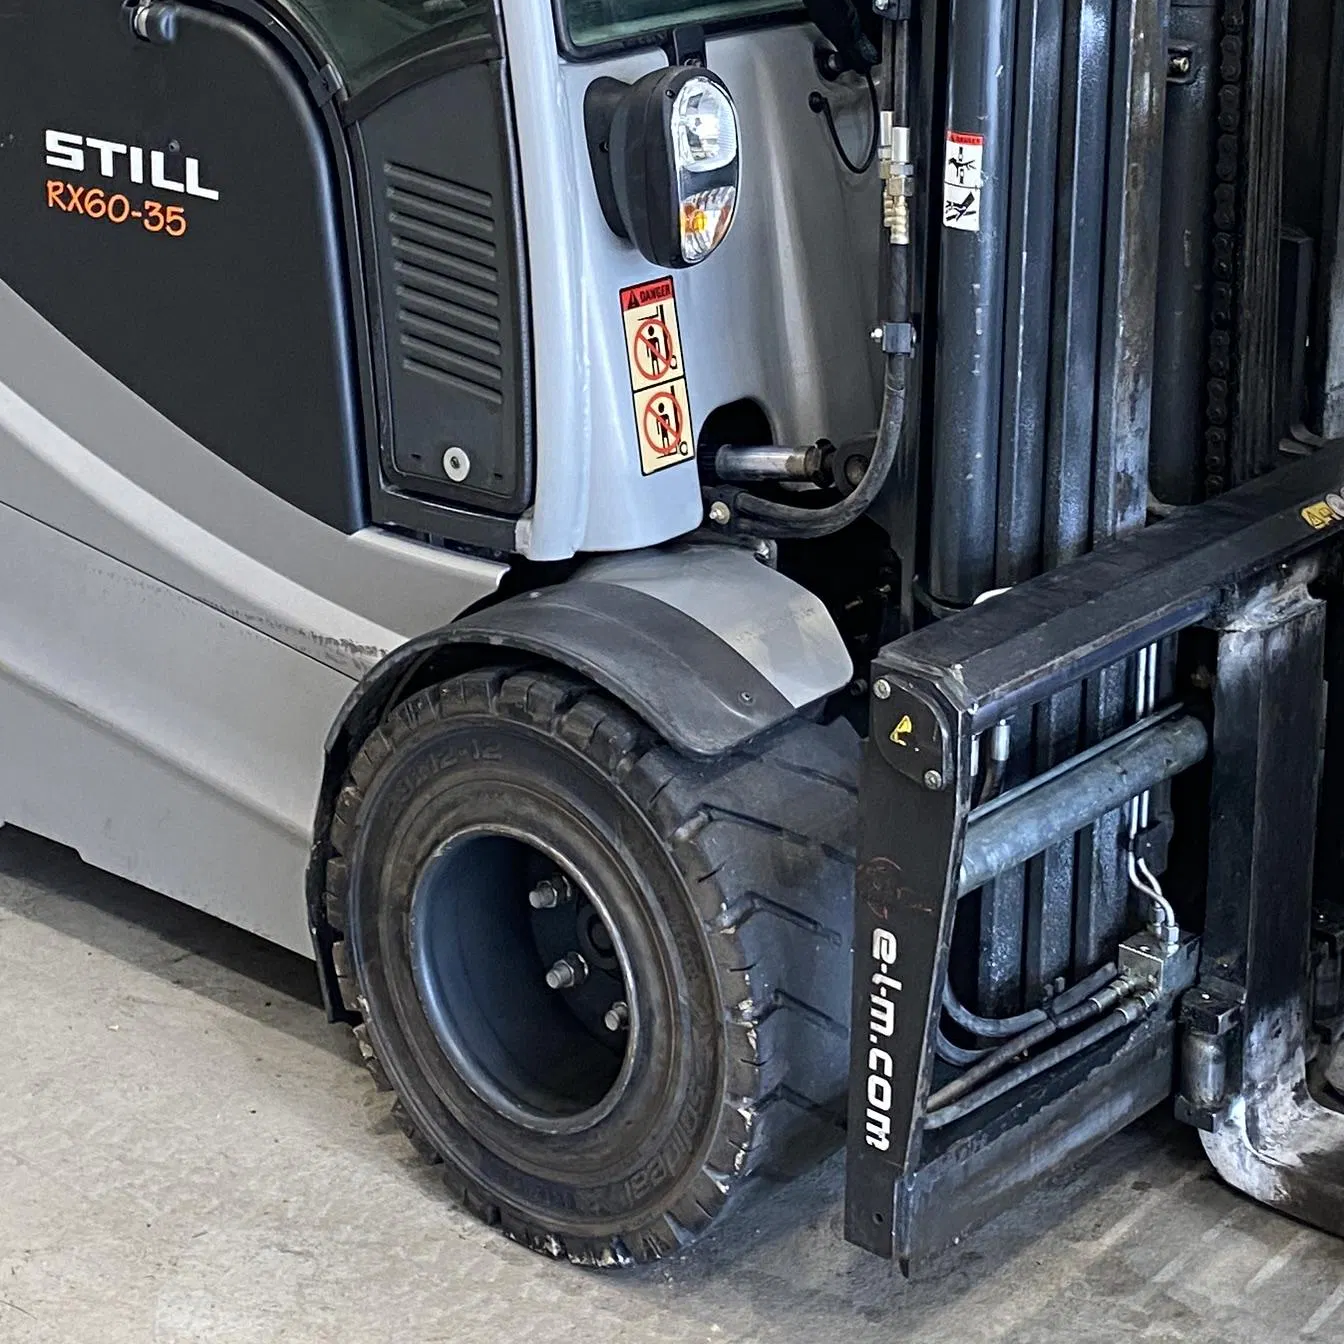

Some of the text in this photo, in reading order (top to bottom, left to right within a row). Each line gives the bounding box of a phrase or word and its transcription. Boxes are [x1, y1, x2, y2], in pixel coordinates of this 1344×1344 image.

[45, 129, 219, 201] STILL
[46, 179, 187, 237] RX60-35
[639, 284, 672, 304] DANGER
